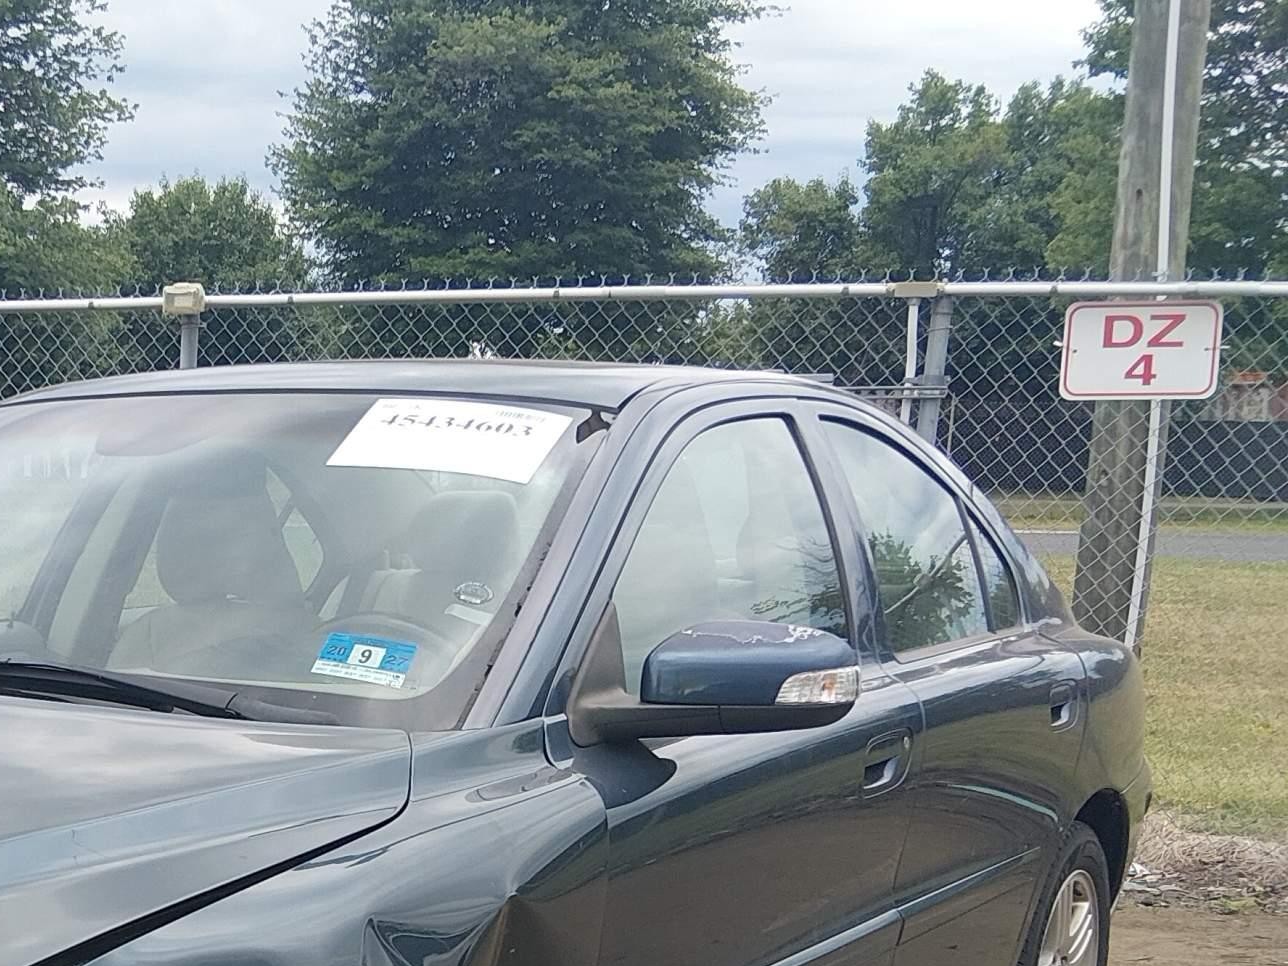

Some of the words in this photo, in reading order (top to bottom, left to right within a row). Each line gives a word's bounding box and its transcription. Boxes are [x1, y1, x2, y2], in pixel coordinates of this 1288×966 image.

[1102, 314, 1187, 349] DZ
[1124, 354, 1157, 386] 4
[381, 413, 533, 437] 45434603
[327, 644, 346, 658] 20
[358, 648, 373, 664] 9
[384, 654, 409, 667] 27
